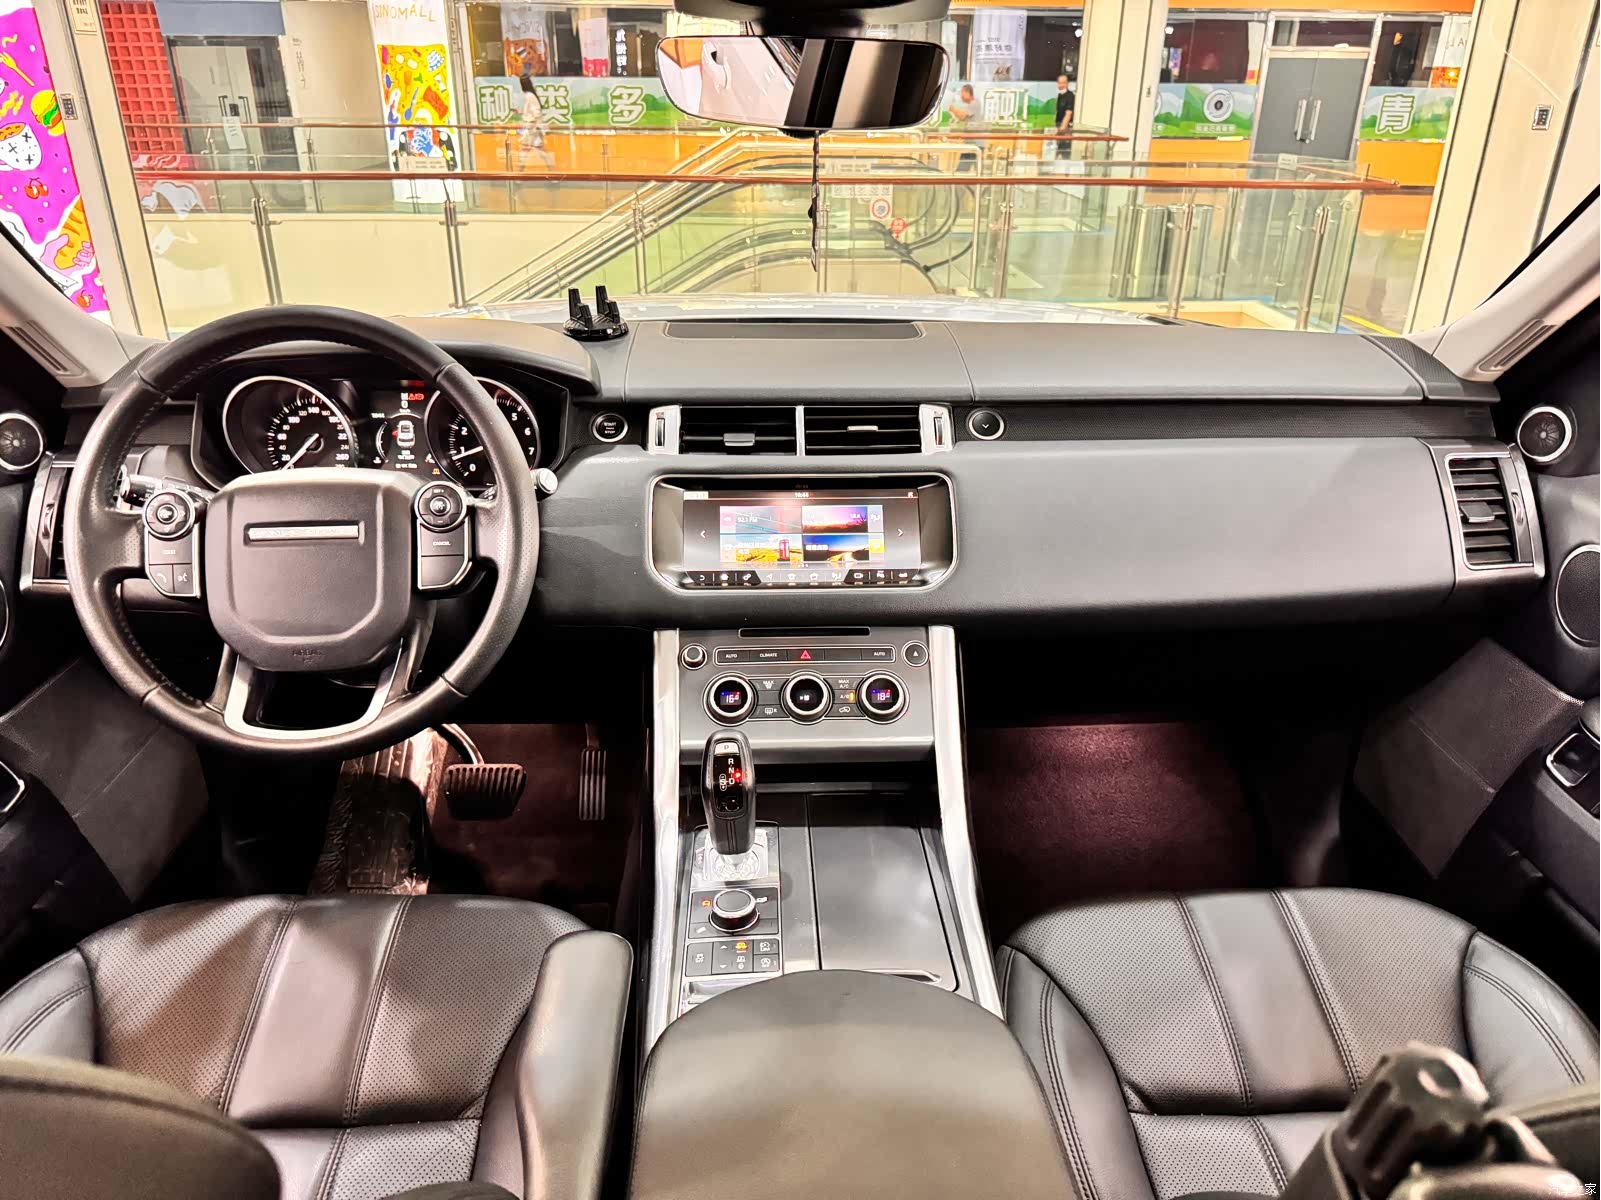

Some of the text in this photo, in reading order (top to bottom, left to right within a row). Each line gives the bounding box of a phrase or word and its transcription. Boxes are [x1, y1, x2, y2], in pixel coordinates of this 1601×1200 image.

[375, 4, 437, 22] SINOMALL
[1376, 94, 1415, 134] 青
[287, 416, 300, 424] 100
[511, 413, 517, 421] 5
[461, 427, 468, 435] 2
[528, 447, 535, 455] 7
[469, 464, 476, 472] 0
